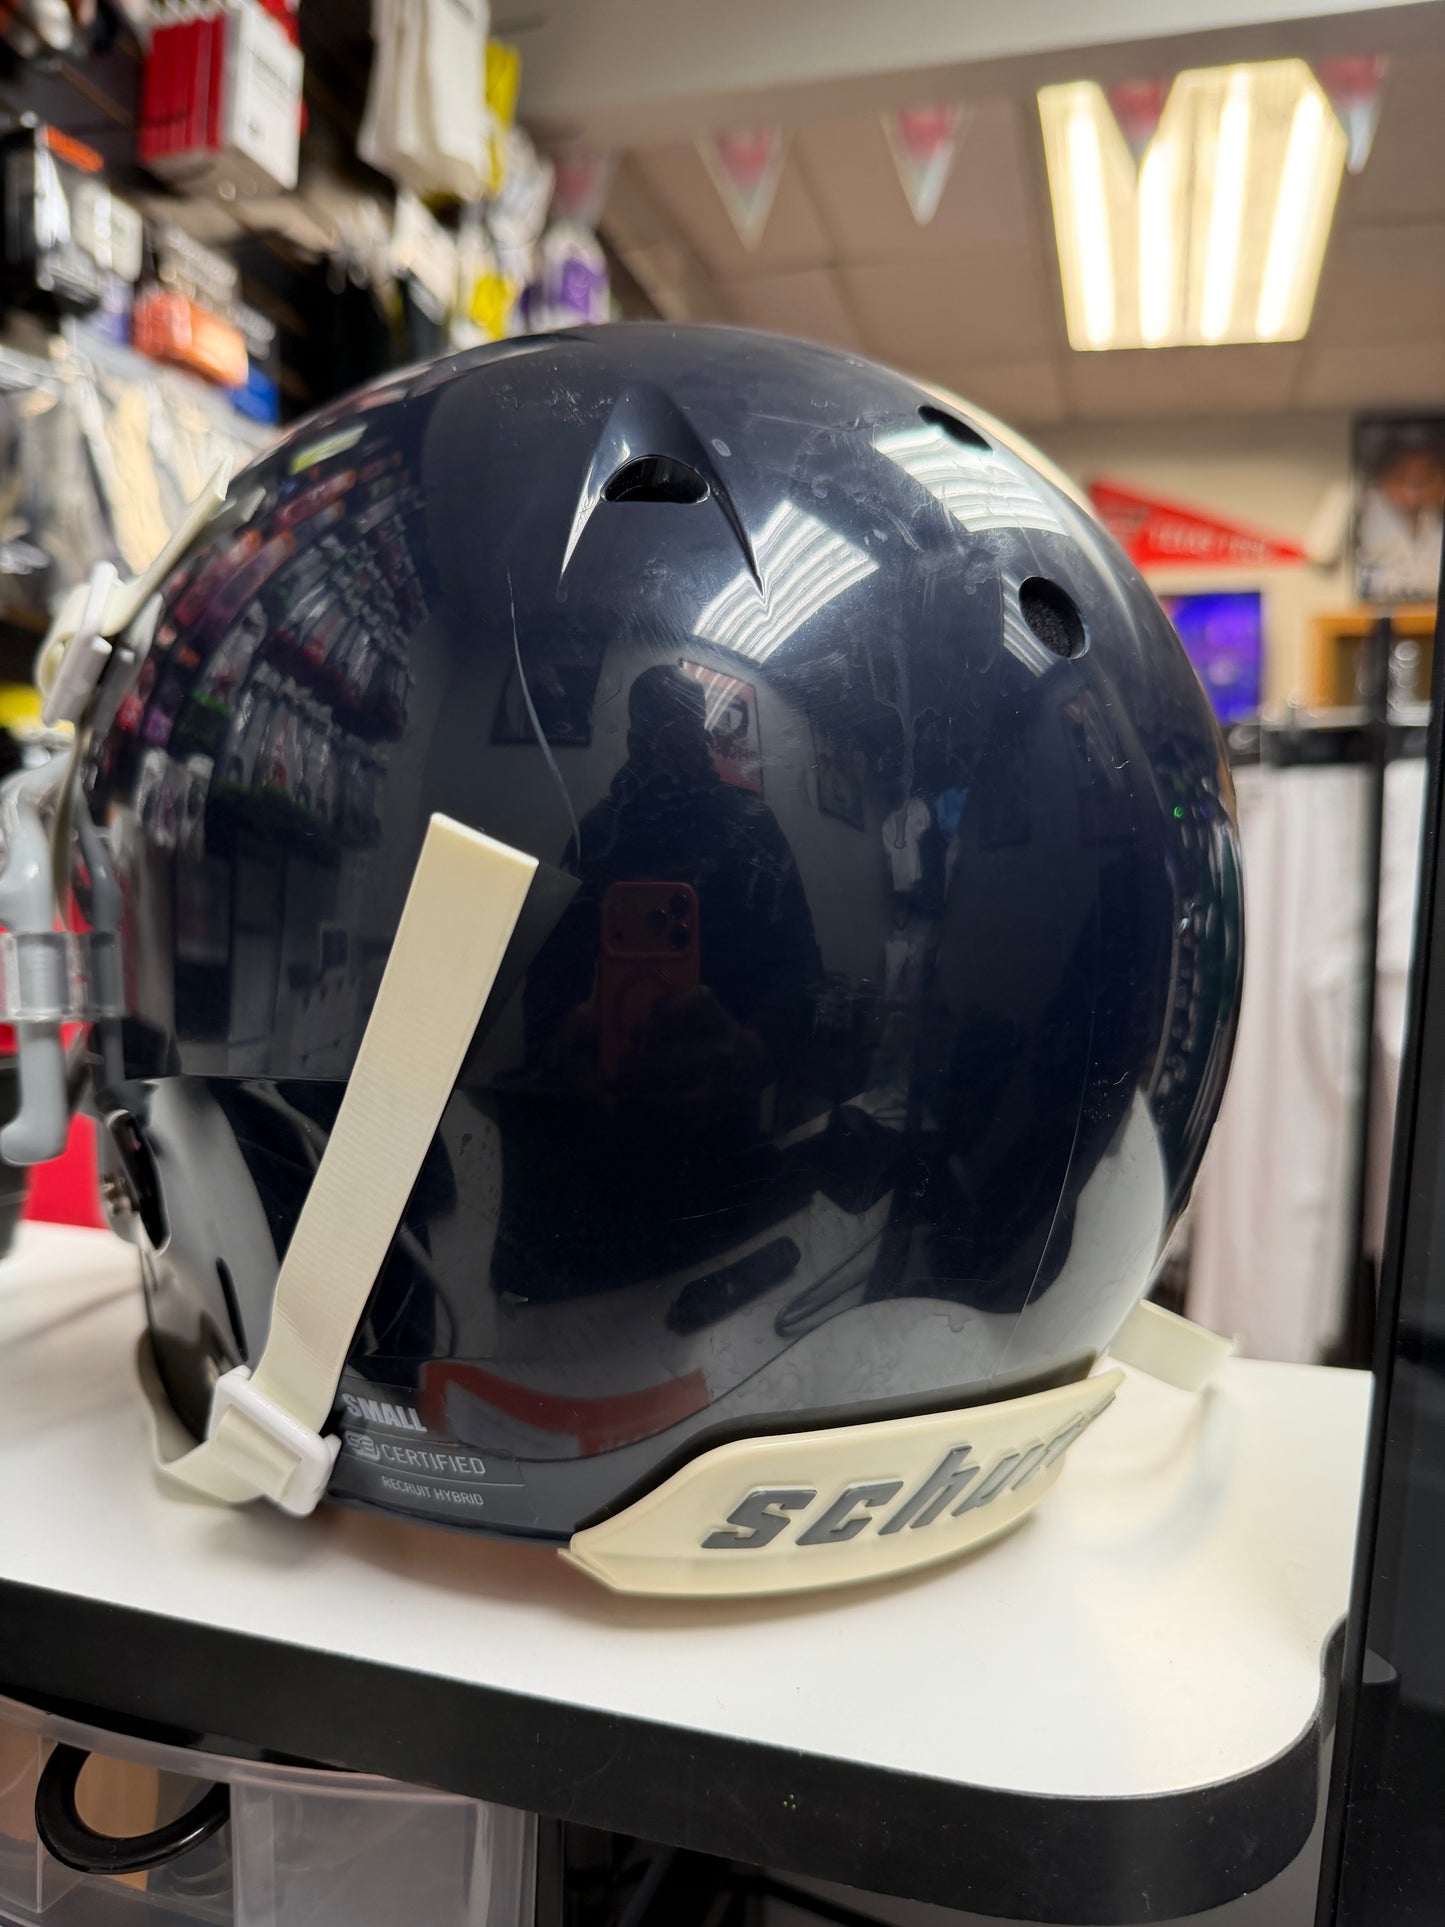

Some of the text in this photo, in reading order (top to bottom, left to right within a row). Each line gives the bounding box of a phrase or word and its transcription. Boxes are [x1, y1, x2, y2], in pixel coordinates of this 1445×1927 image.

[342, 1393, 428, 1432] SMALL
[381, 1443, 486, 1474] CERTIFIED
[381, 1475, 484, 1505] RECRUIT HYBRID
